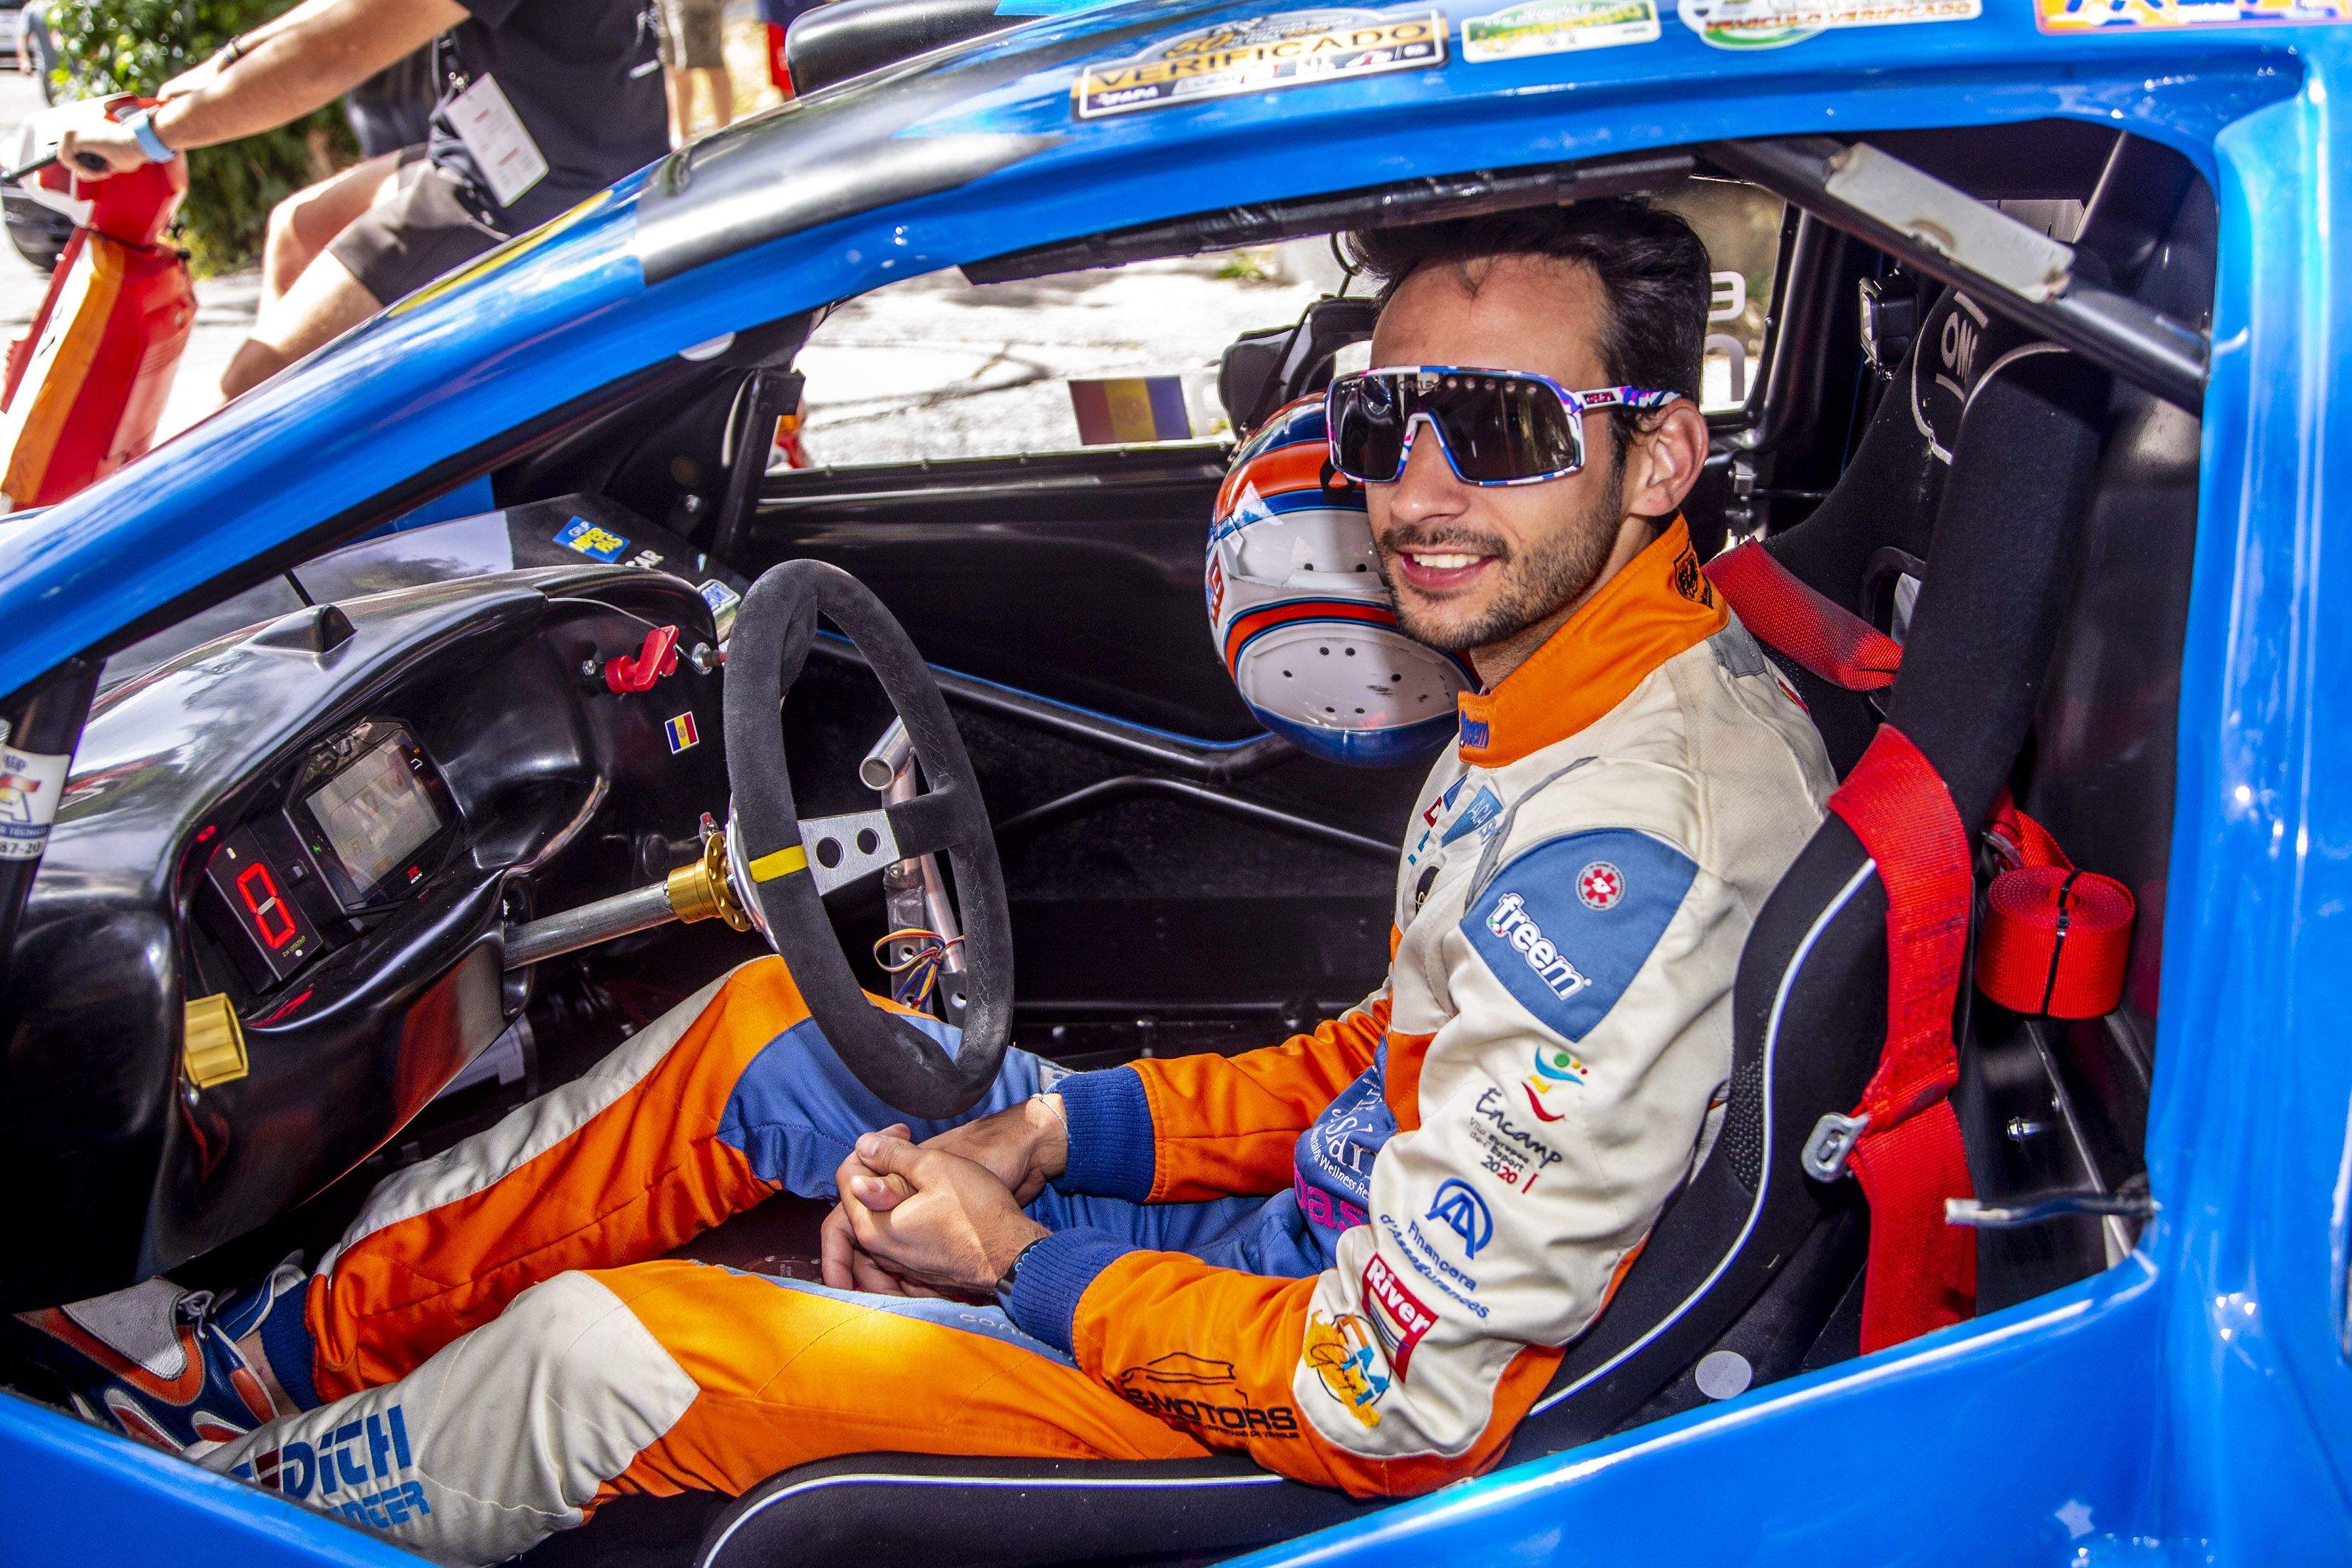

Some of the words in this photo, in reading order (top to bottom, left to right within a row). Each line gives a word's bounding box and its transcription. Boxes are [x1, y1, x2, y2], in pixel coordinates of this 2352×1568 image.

[1829, 3, 1973, 21] VERIFICADO
[1096, 25, 1426, 87] VERIFICADO
[1488, 894, 1584, 999] freem
[1475, 1088, 1563, 1169] Encamp
[1319, 1160, 1357, 1190] Wellness
[1481, 1155, 1518, 1185] 2020
[1408, 1219, 1477, 1292] Financera
[1366, 1257, 1430, 1334] River
